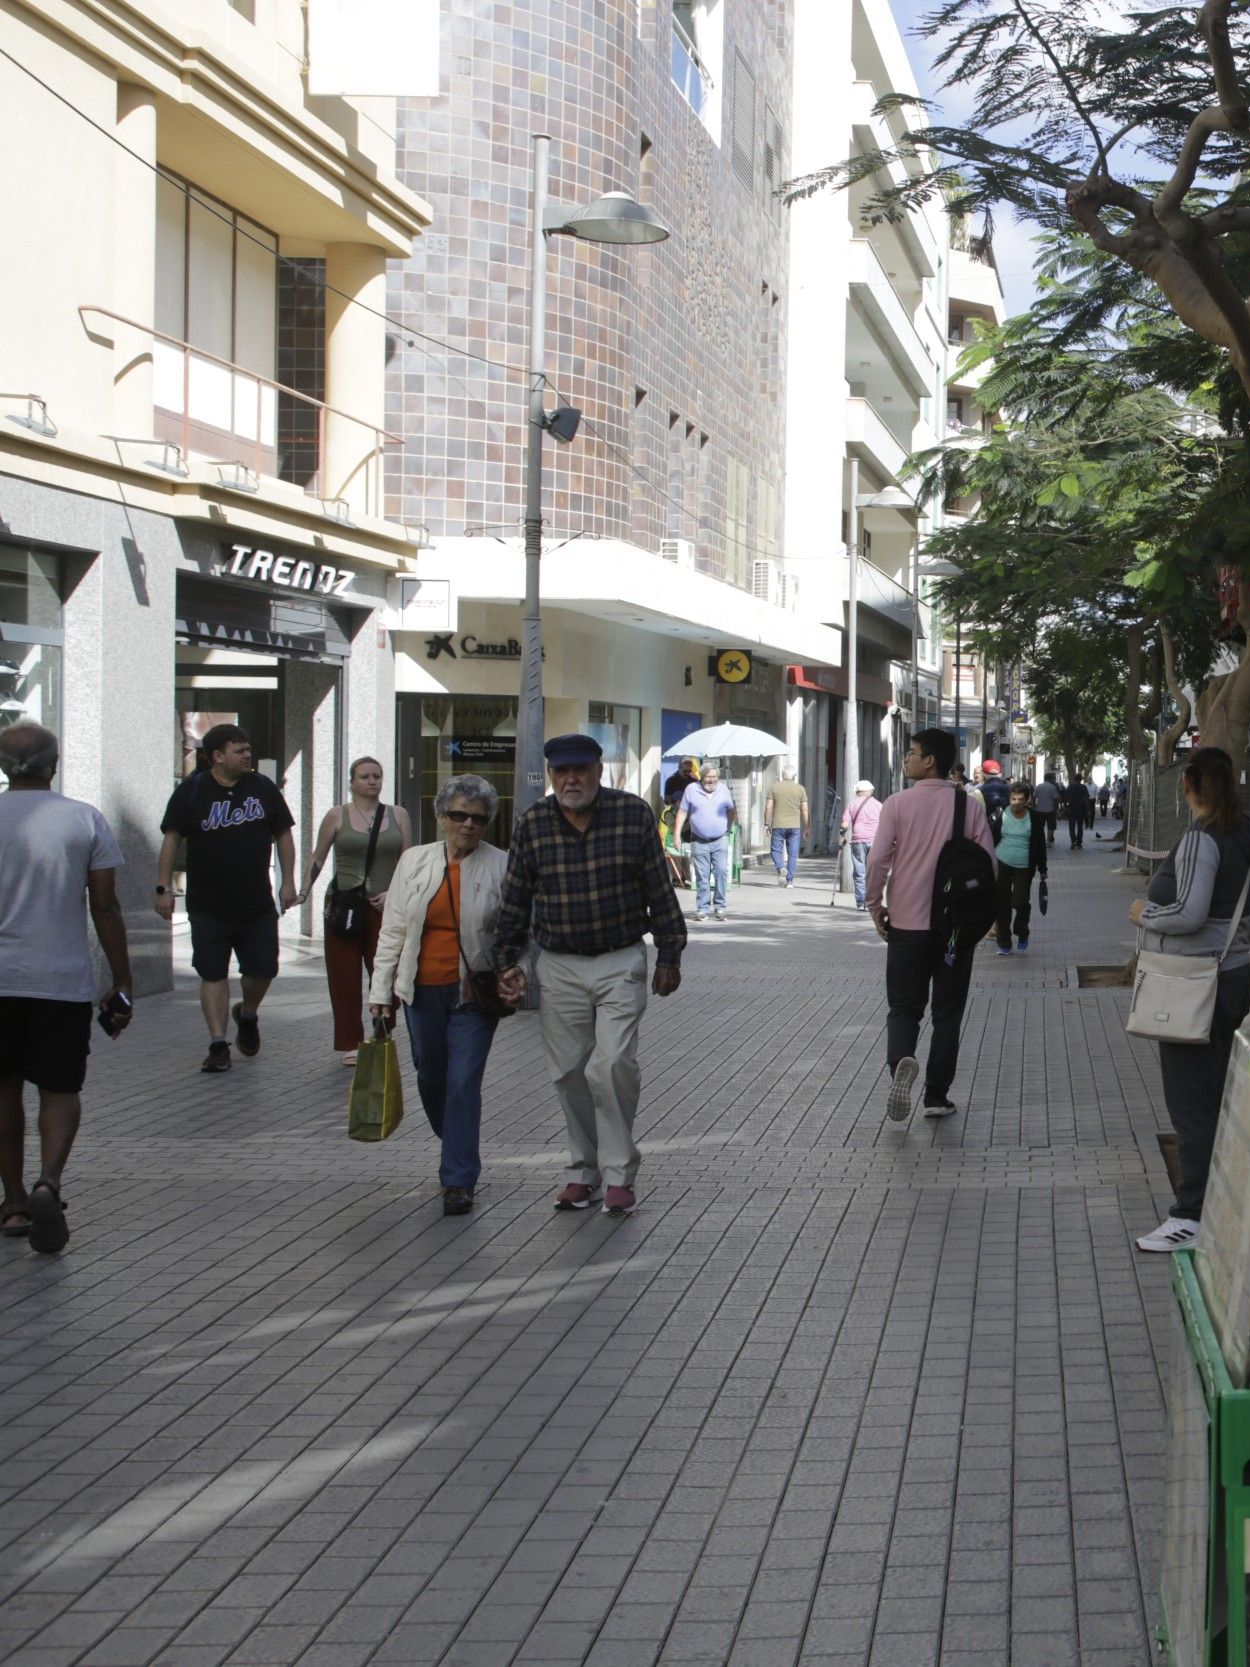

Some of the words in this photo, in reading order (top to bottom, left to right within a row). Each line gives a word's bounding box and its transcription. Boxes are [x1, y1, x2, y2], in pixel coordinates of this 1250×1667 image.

[462, 740, 482, 748] Centro
[482, 740, 490, 748] de
[202, 797, 265, 831] Mets
